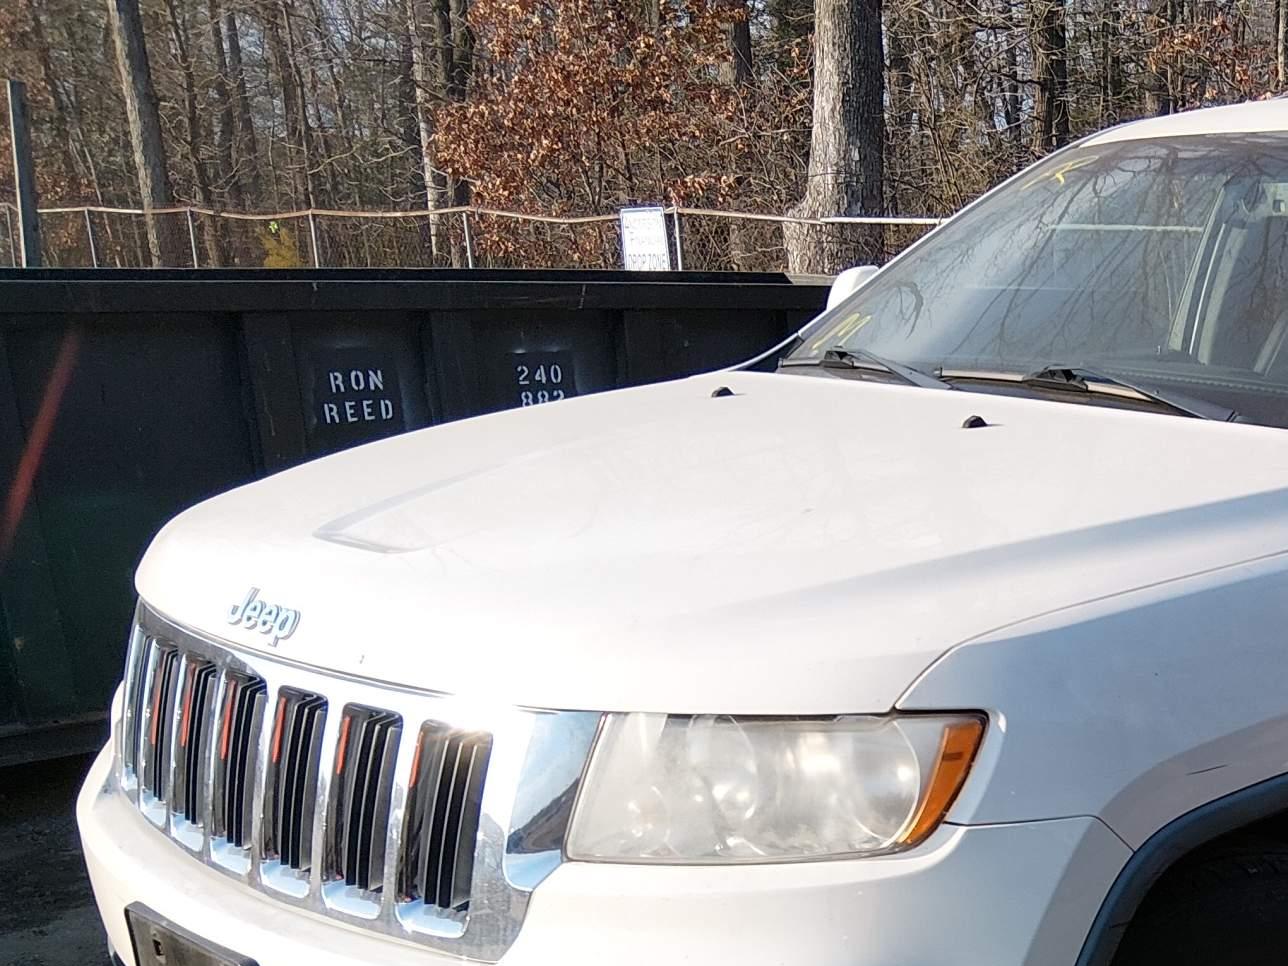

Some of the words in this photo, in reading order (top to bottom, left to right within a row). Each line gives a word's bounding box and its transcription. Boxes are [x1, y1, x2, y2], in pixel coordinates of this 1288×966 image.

[329, 369, 384, 393] RON
[517, 365, 562, 385] 240
[324, 399, 394, 424] REED
[228, 587, 301, 647] Jeep
